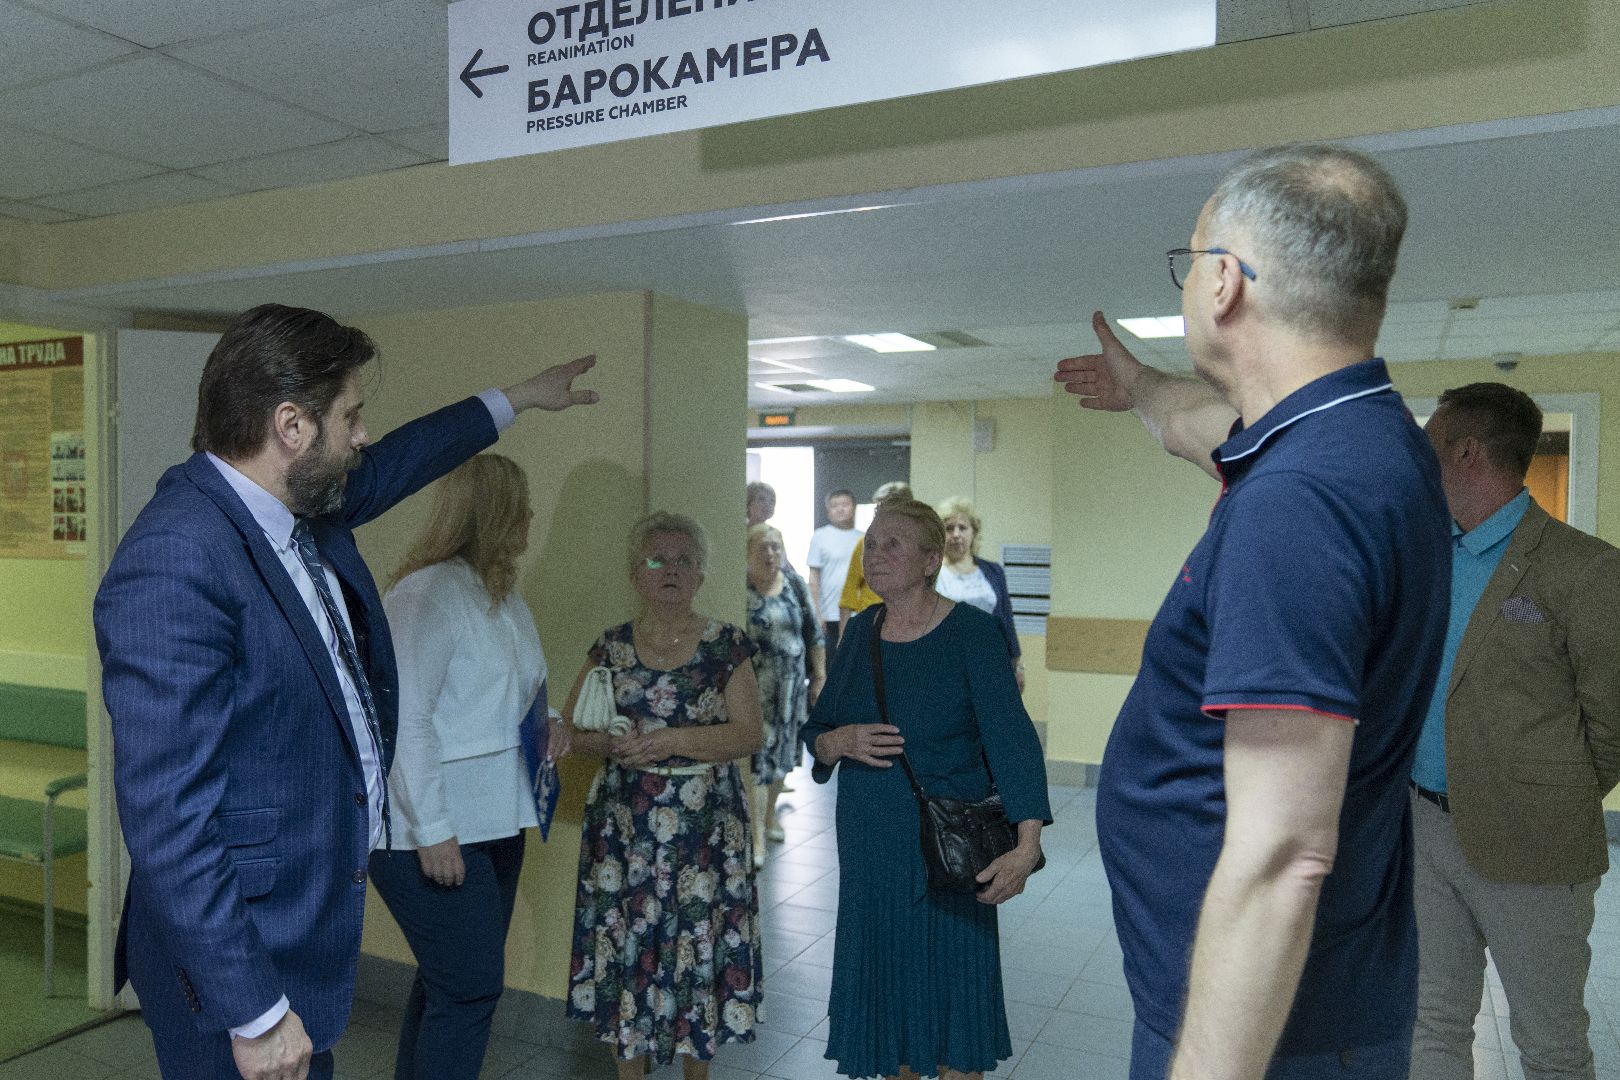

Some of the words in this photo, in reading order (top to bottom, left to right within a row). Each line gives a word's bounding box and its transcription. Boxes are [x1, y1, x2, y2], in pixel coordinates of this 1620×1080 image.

[527, 34, 634, 67] REANIMATION
[528, 28, 831, 113] БАРОКАМЕРА
[526, 109, 605, 133] PRESSURE
[608, 95, 688, 119] CHAMBER
[18, 342, 66, 365] ТРУДА
